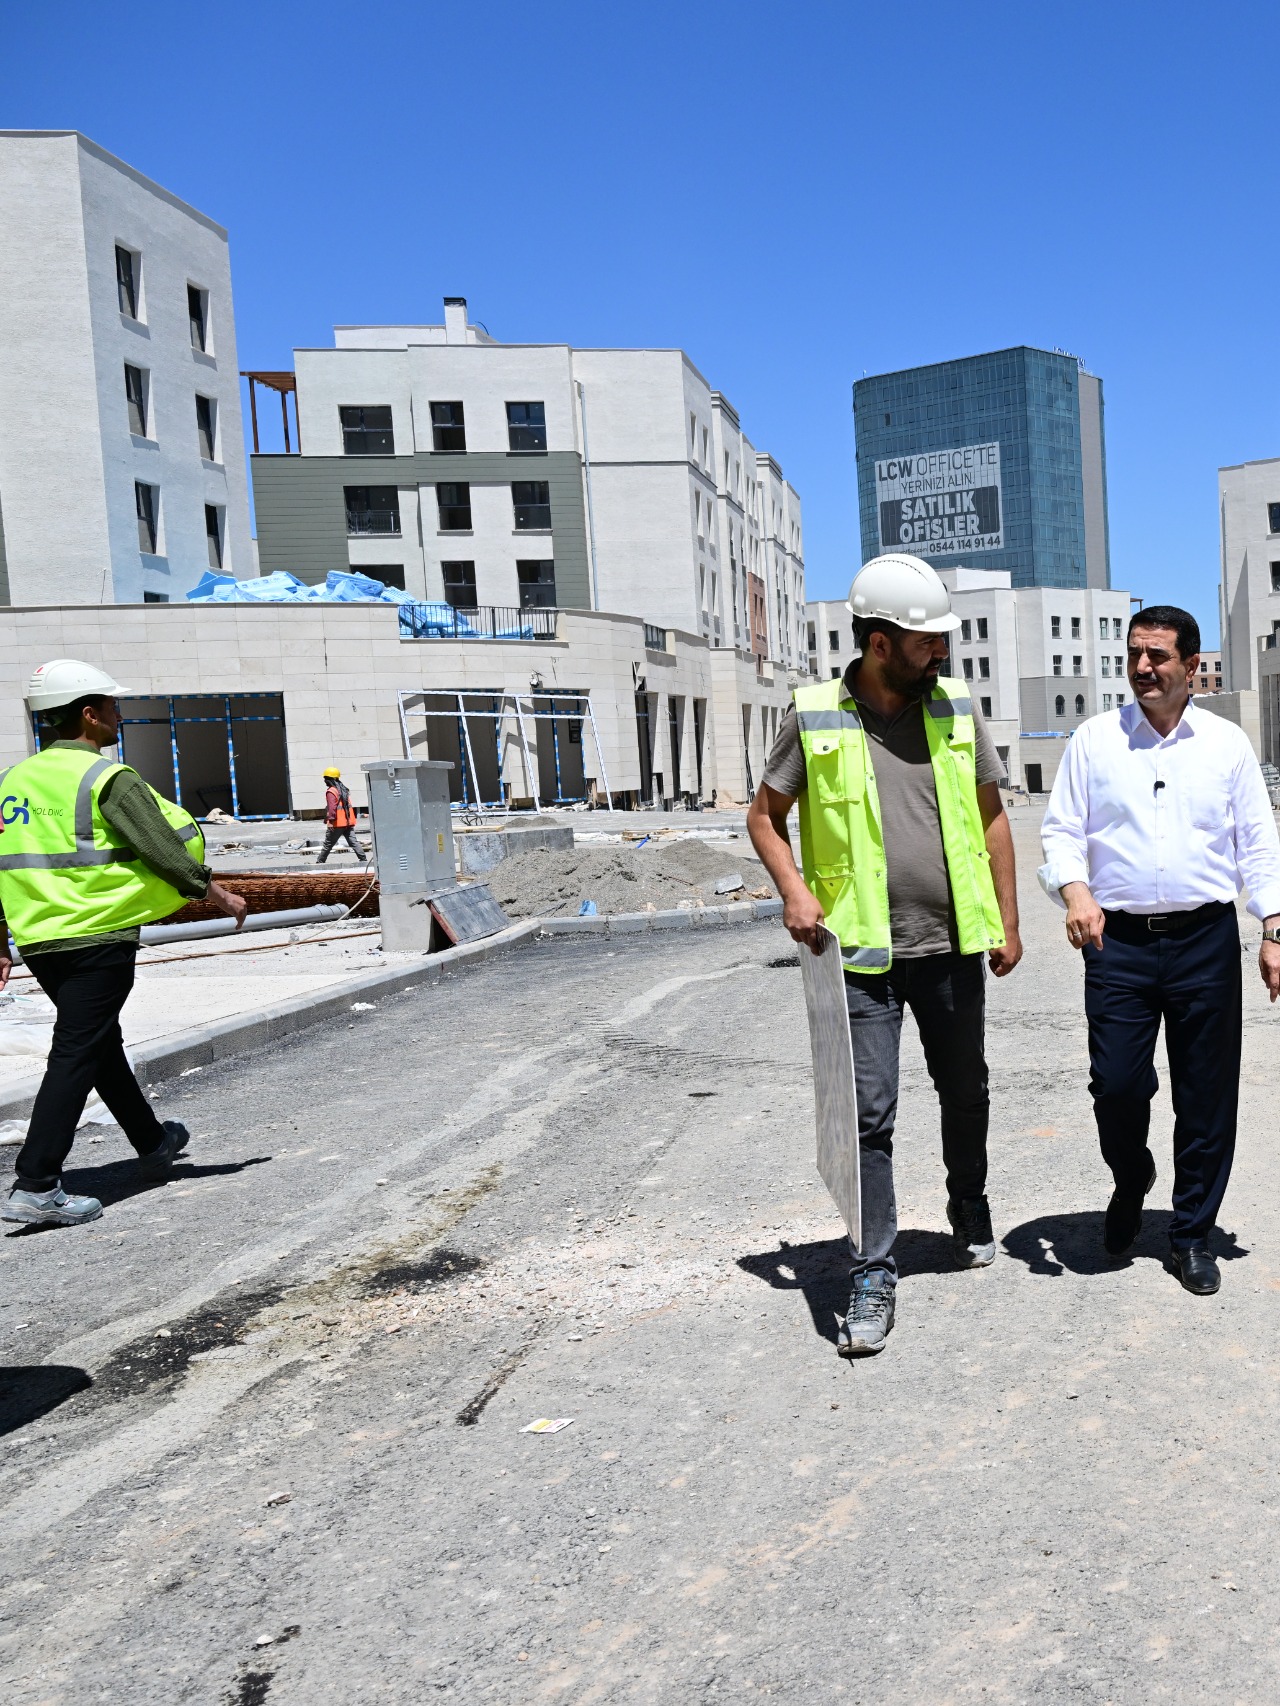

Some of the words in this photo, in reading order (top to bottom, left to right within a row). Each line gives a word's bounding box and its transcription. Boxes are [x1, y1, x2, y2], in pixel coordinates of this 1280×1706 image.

[878, 459, 913, 481] LCW
[917, 446, 997, 475] OFFICE'TE
[901, 490, 976, 521] SATILIK
[929, 540, 955, 553] 0544
[957, 538, 972, 549] 114
[974, 537, 985, 548] 91
[987, 535, 1001, 547] 44
